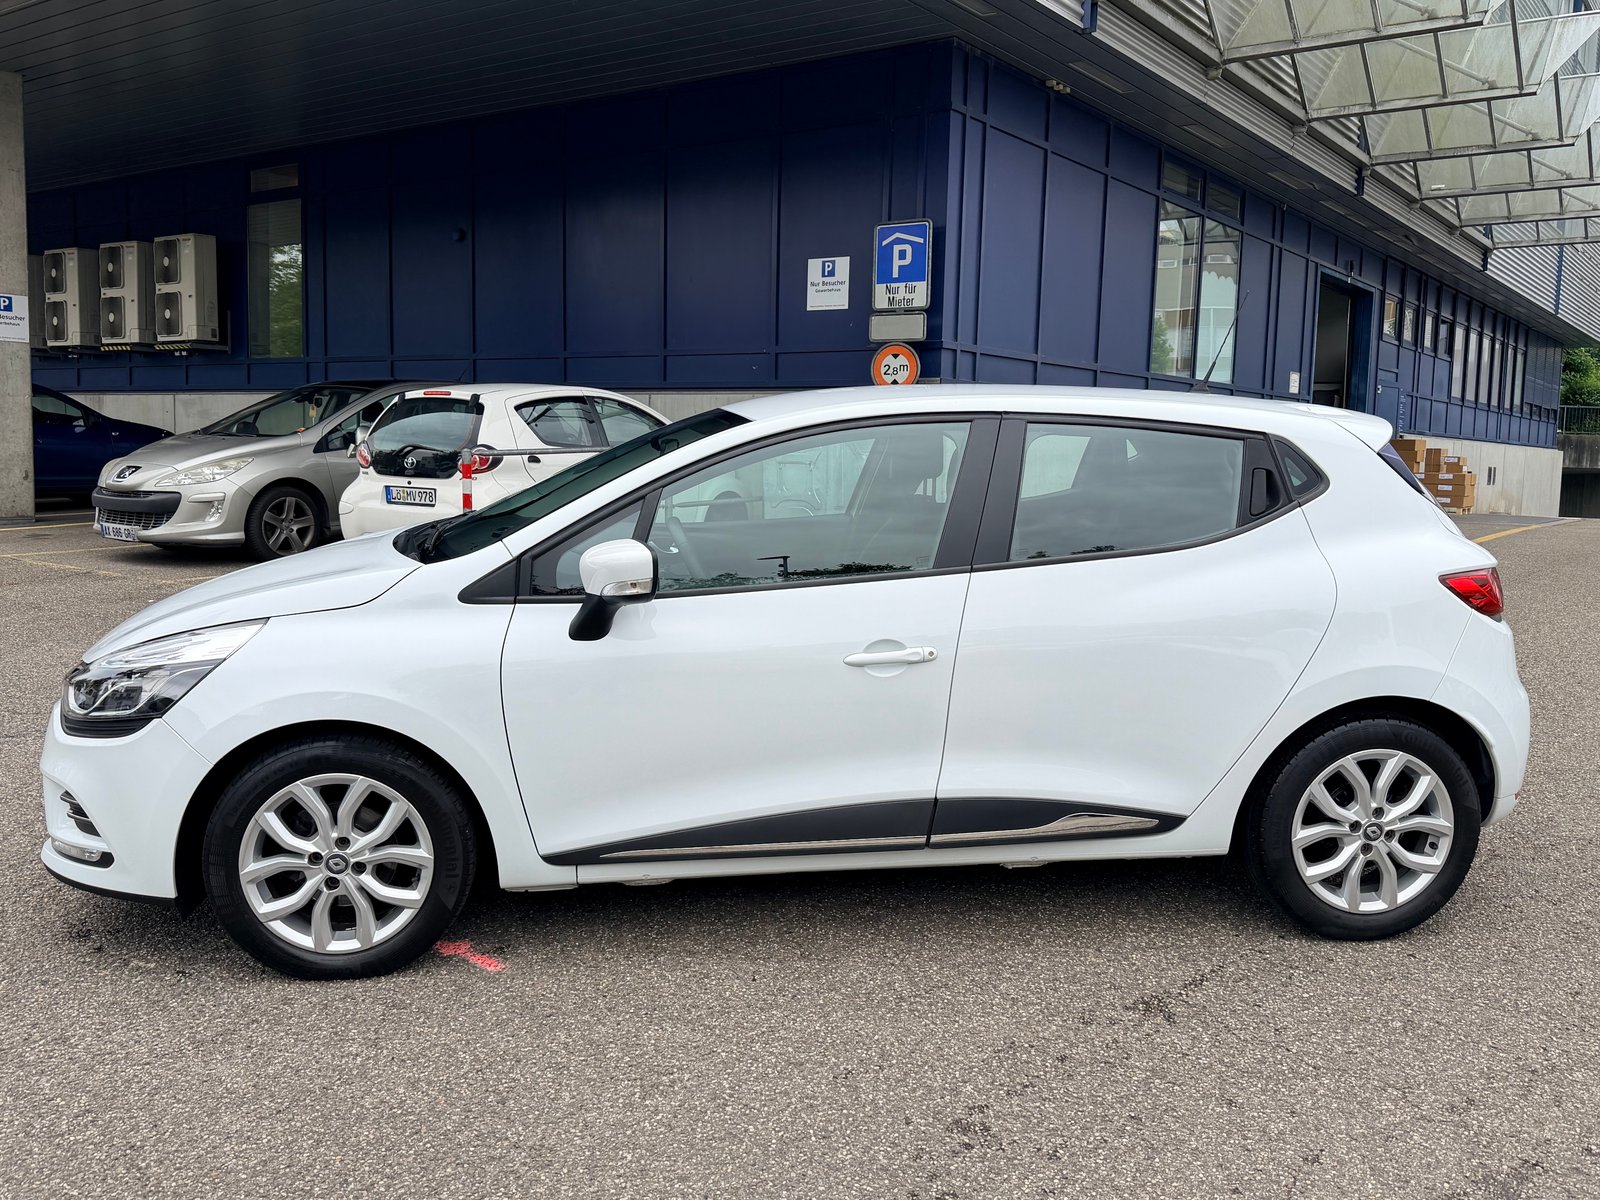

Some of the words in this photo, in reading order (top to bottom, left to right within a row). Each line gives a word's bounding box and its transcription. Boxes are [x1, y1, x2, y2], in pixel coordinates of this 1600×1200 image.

[892, 244, 912, 278] P
[825, 262, 833, 276] P
[885, 284, 900, 295] Nur
[904, 283, 917, 294] für
[887, 296, 915, 307] Mieter
[391, 489, 401, 501] LÖ
[406, 490, 417, 502] MV
[418, 491, 434, 503] 978
